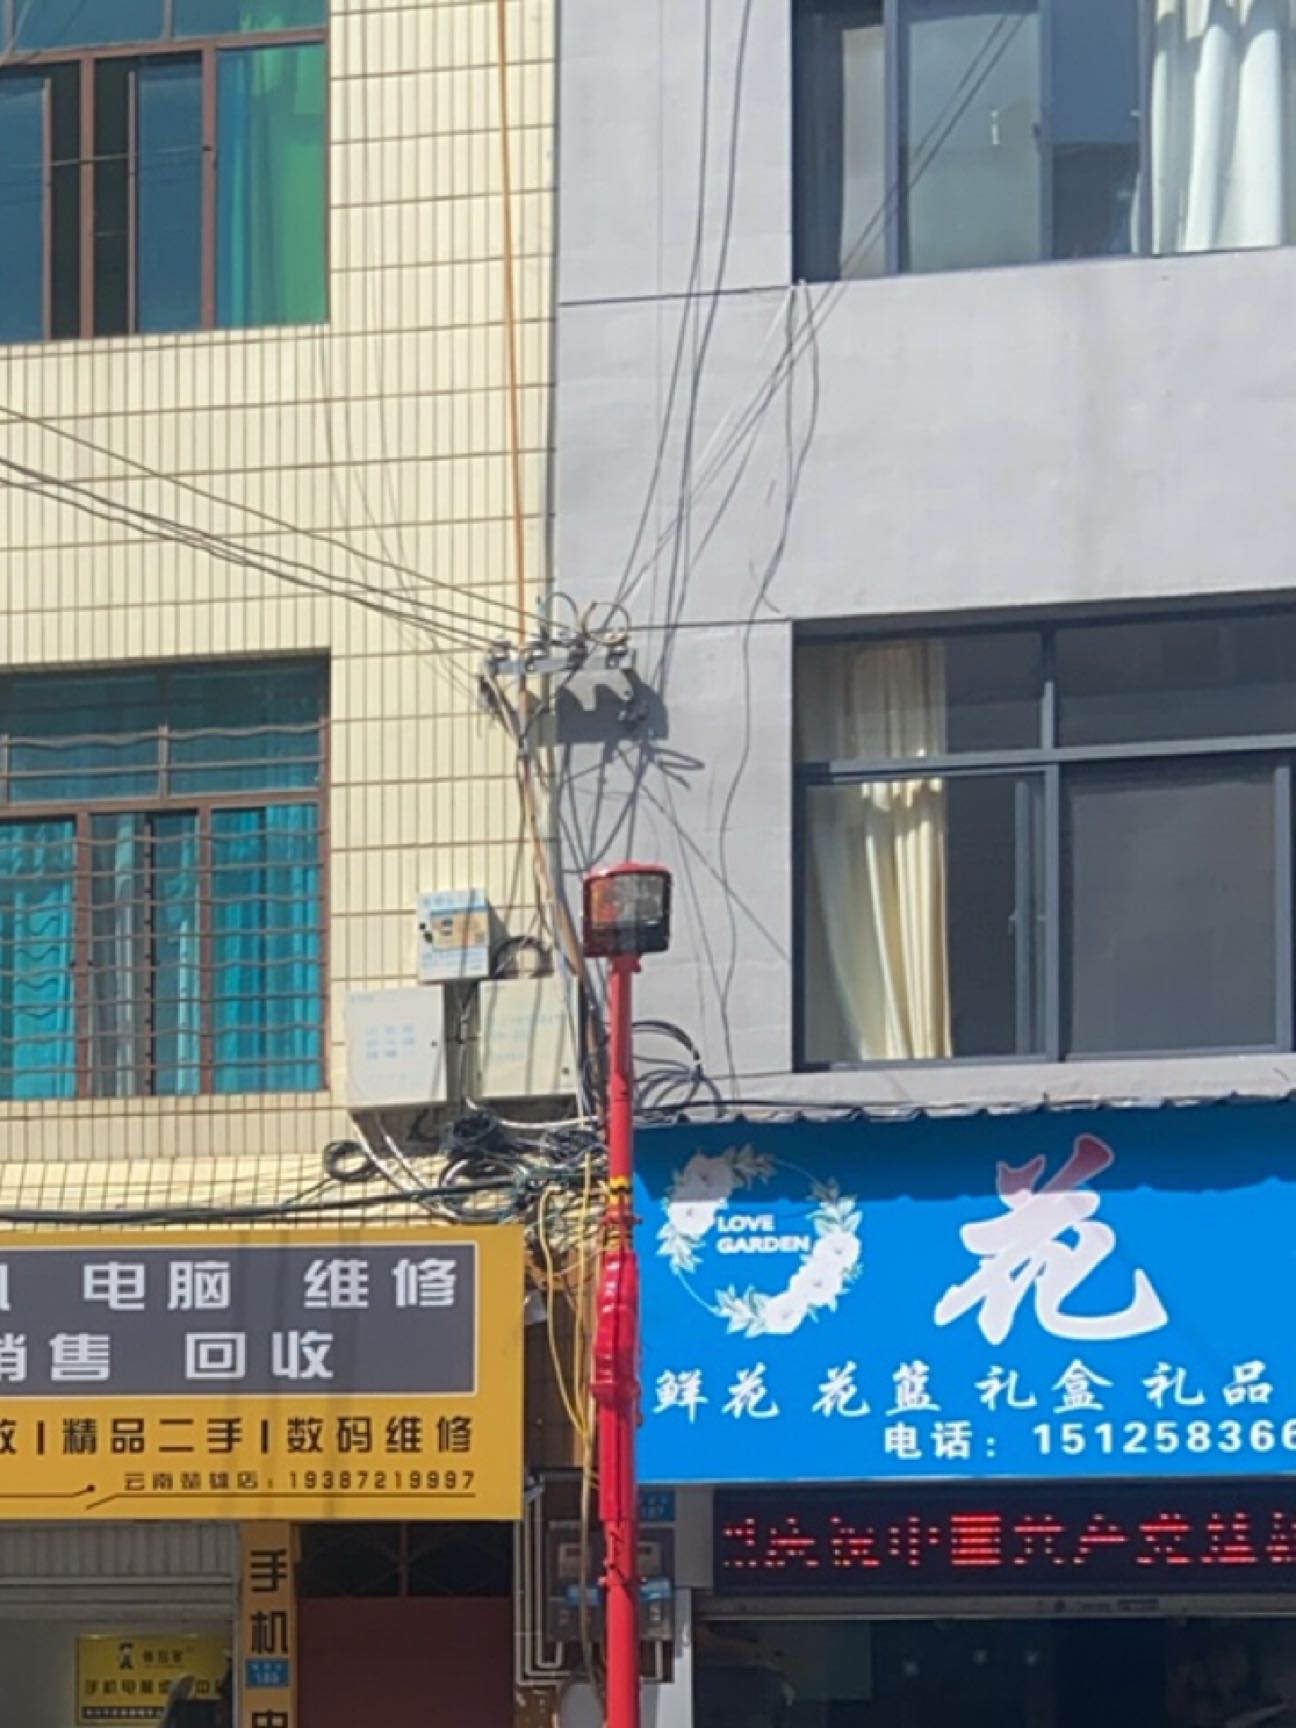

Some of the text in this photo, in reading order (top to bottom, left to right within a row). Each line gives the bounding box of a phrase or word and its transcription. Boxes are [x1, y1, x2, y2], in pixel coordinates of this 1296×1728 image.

[717, 1235, 810, 1254] GARDEN
[718, 1214, 774, 1233] LOVE
[933, 1134, 1169, 1345] 花
[82, 1261, 231, 1310] 电脑
[304, 1258, 459, 1308] 维修
[184, 1331, 334, 1381] 回收
[654, 1360, 1275, 1423] 鲜花 花篮 礼盒 礼品
[251, 1549, 288, 1654] 手机
